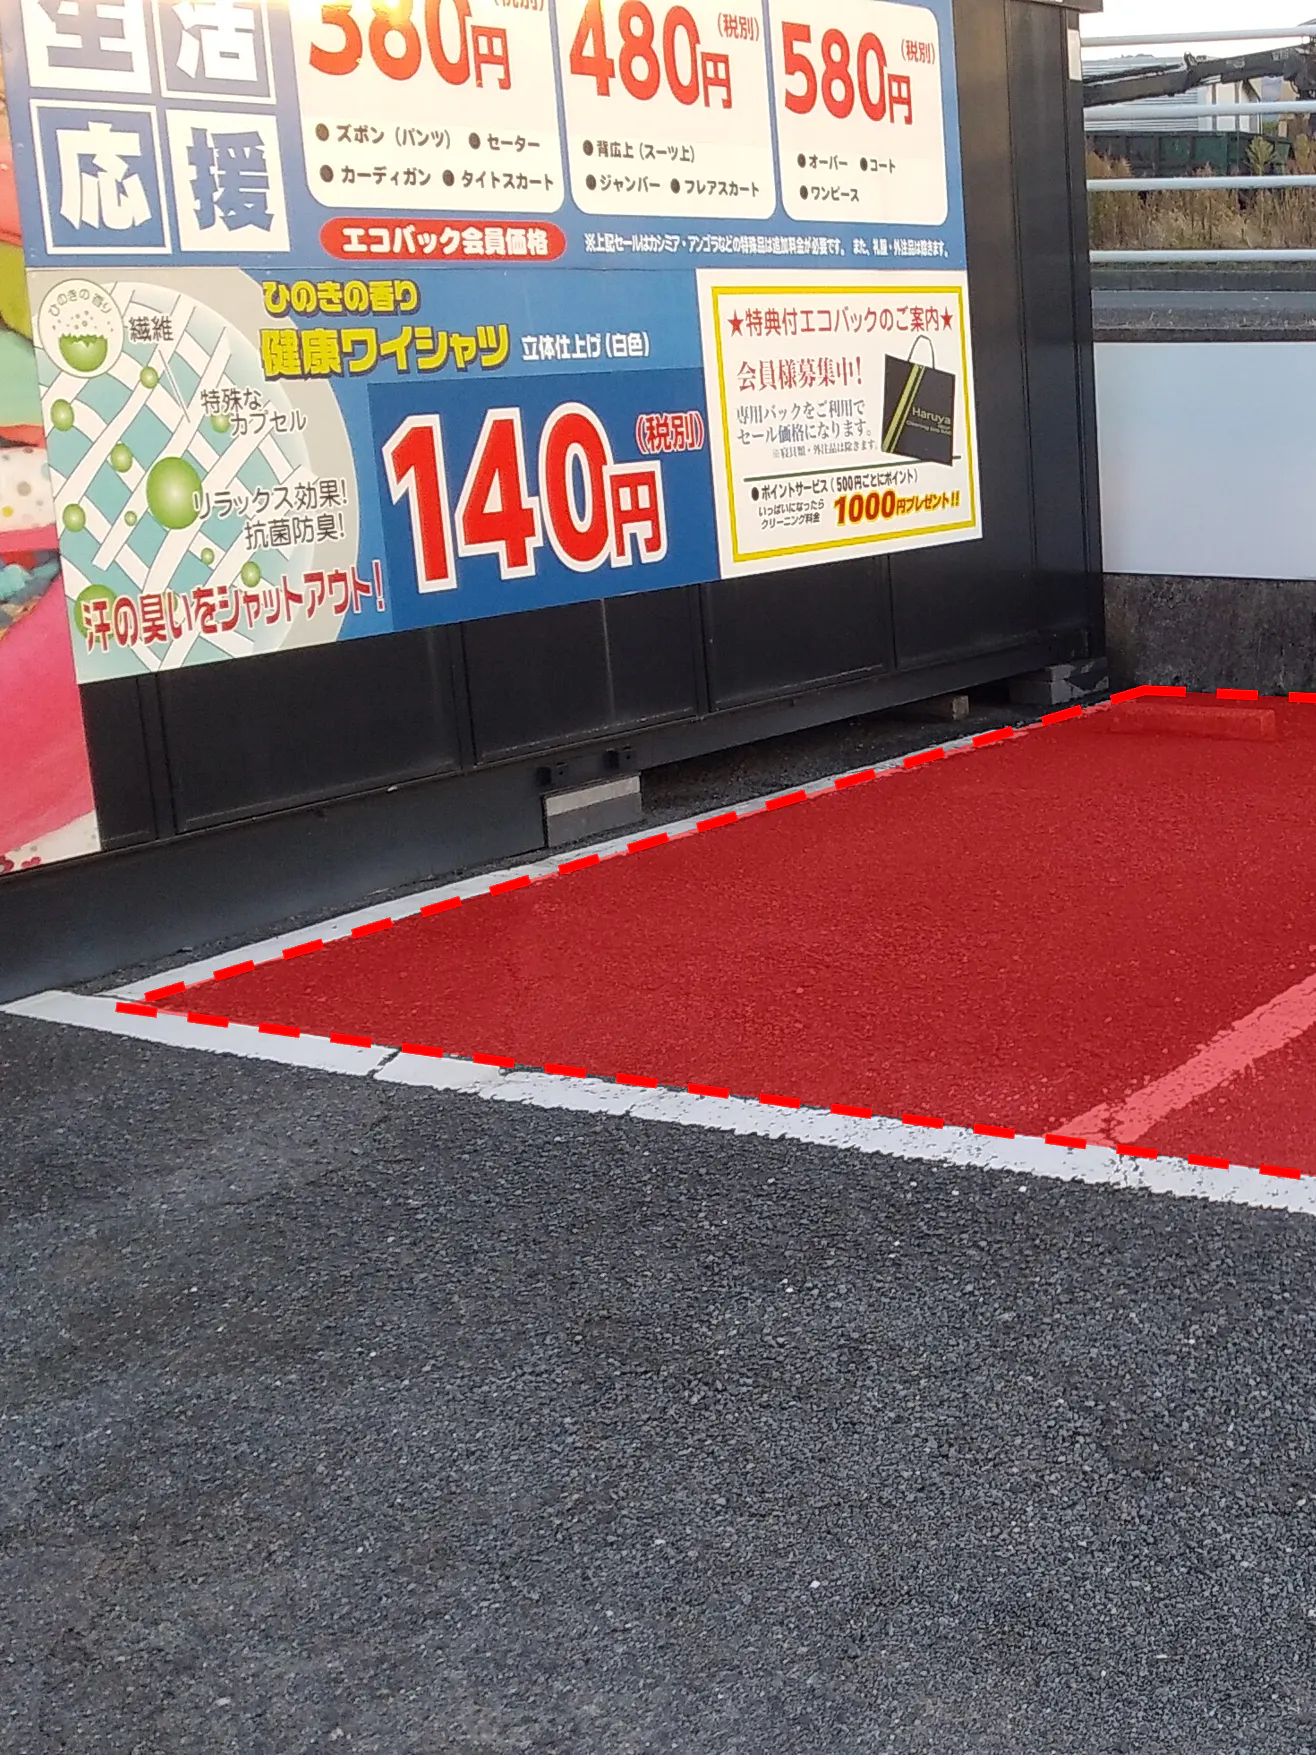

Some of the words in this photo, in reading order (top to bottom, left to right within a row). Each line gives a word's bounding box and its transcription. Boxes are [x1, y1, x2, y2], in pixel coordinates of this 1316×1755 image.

[717, 12, 759, 42] （税別）
[38, 0, 258, 82] 生活
[569, 0, 732, 109] 480円
[901, 38, 935, 65] （税別）
[781, 21, 913, 125] 580円
[487, 133, 541, 152] セーター
[56, 121, 277, 232] 応援
[809, 154, 848, 171] オーバー
[870, 158, 896, 173] コート
[341, 166, 431, 186] カーディガン
[461, 170, 554, 191] タイトスカート
[684, 179, 759, 197] フレアスカート
[811, 185, 860, 202] ワンピース
[262, 279, 420, 315] ひのきの香り
[128, 315, 174, 342] 繊維
[260, 323, 510, 377] 健康ワイシャツ
[200, 387, 262, 414] 特殊な
[231, 409, 307, 436] カプセル
[912, 407, 951, 424] Haruya
[636, 411, 704, 454] （税別）
[193, 478, 348, 520] リラックス効果！
[386, 406, 665, 589] 140円
[759, 499, 825, 516] いっぱいになったら
[244, 512, 345, 550] 抗菌防臭！
[761, 512, 821, 530] クリーニング料金
